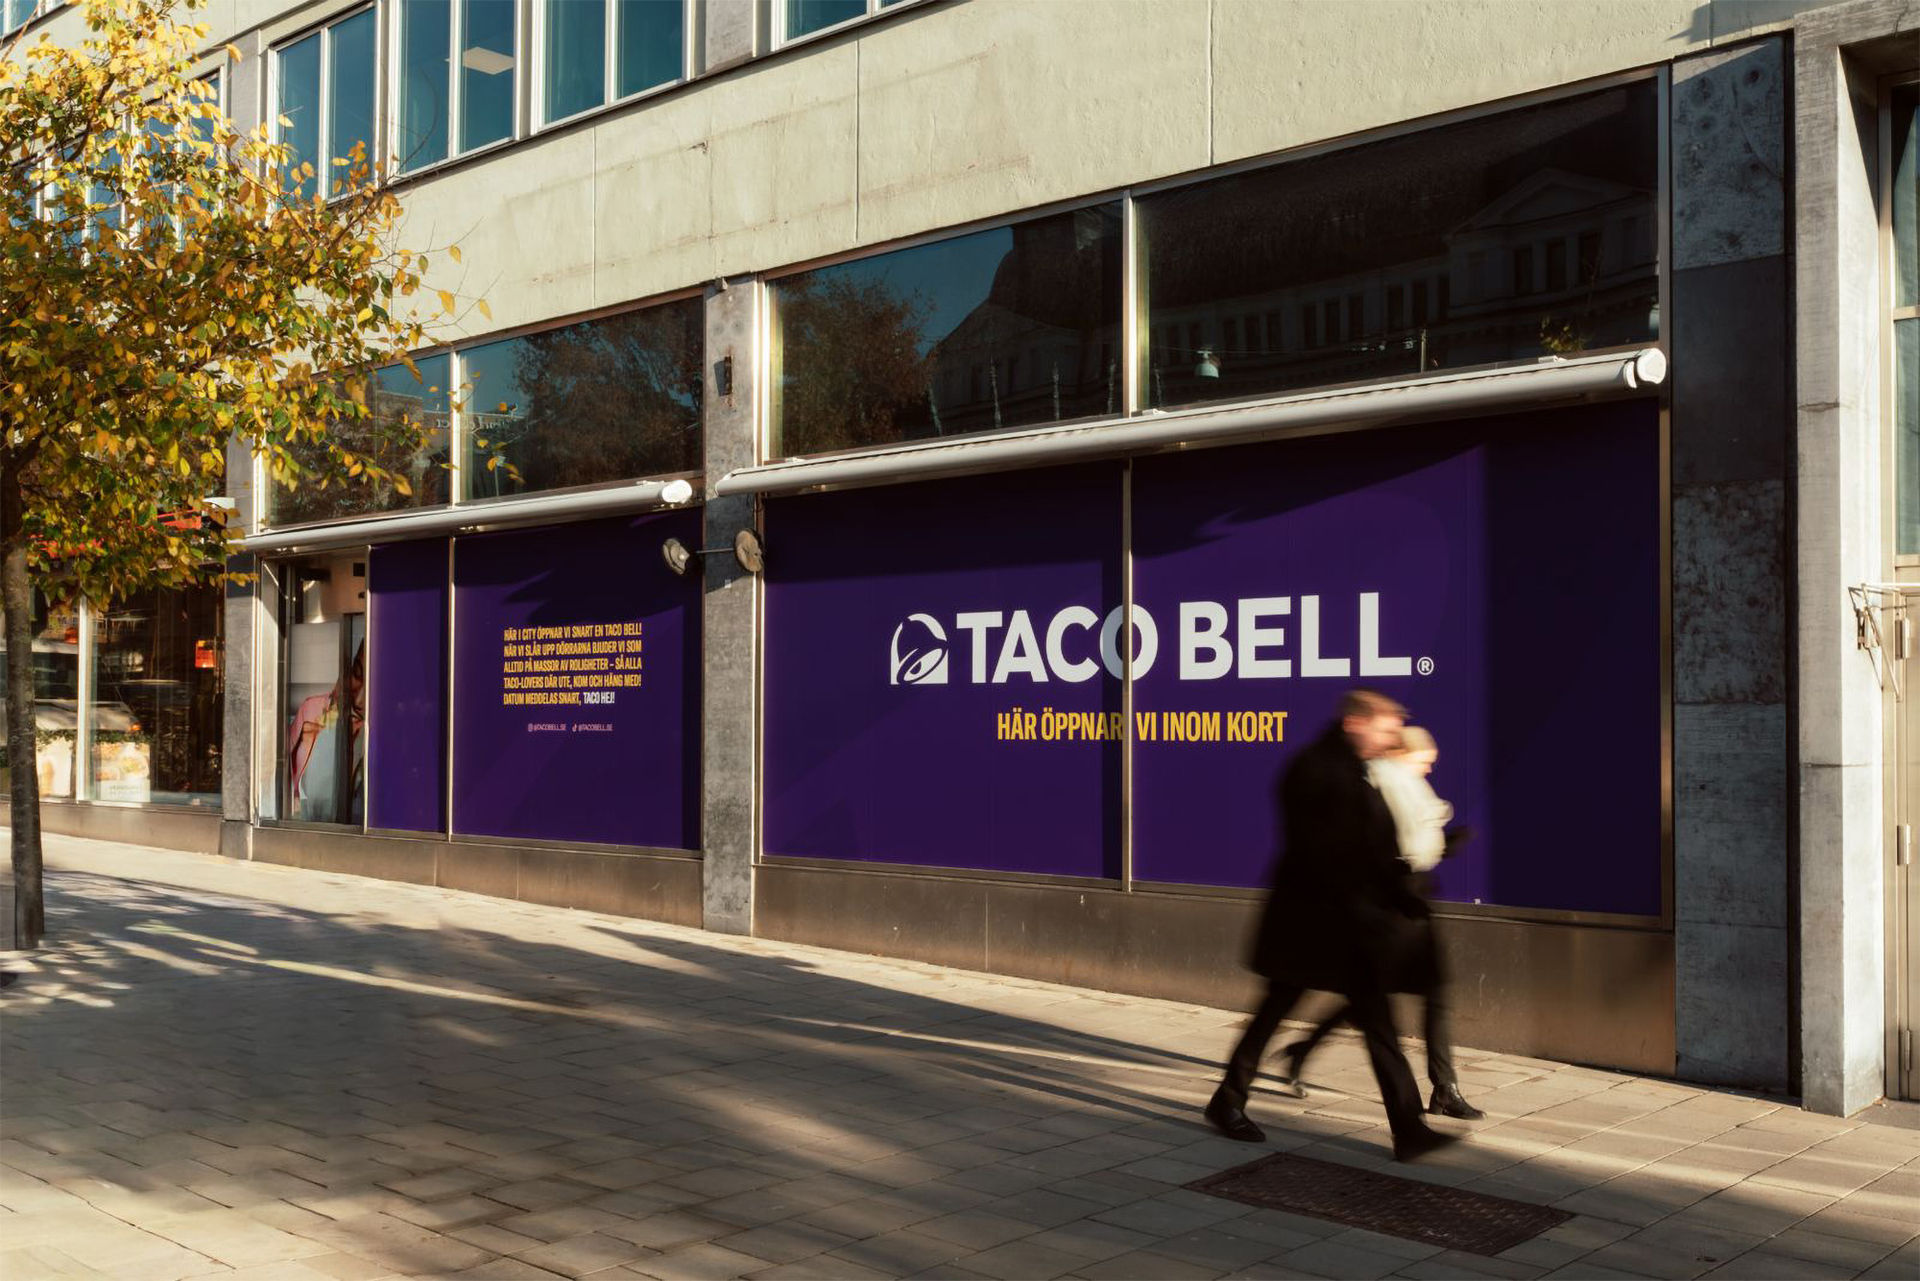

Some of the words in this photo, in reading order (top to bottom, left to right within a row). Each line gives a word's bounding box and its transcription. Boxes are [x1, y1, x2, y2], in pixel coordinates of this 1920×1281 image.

[522, 628, 536, 640] CITY
[537, 626, 563, 639] ÖPPNAR
[564, 626, 571, 638] VI
[572, 625, 594, 638] SNART
[595, 624, 603, 637] EN
[605, 624, 622, 636] TACO
[623, 622, 642, 635] BELL!
[518, 645, 524, 656] VI
[525, 641, 541, 656] SLÅR
[542, 643, 555, 656] UPP
[556, 641, 591, 655] DÖRRARNA
[592, 641, 617, 653] BJUDER
[618, 640, 625, 653] VI
[626, 640, 642, 653] SOM
[956, 604, 1159, 684] TACO
[504, 661, 524, 673] ALLTID
[525, 657, 533, 672] PÅ
[534, 660, 559, 672] MASSOR
[560, 659, 568, 671] AV
[569, 658, 608, 671] ROLIGHETER
[615, 654, 624, 670] SÅ
[625, 657, 642, 670] ALLA
[504, 676, 543, 688] TACO-LOVERS
[544, 674, 558, 688] DÄR
[558, 676, 572, 689] UTE,
[573, 675, 588, 688] KOM
[589, 675, 603, 687] OCH
[604, 672, 623, 687] HÄNG
[624, 674, 642, 686] MED!
[504, 692, 524, 705] DATUM
[525, 692, 558, 704] MEDDELAS
[559, 692, 581, 706] SNART,
[583, 692, 600, 704] TACO
[601, 691, 615, 704] HEJ!
[997, 707, 1037, 741] HÄR
[1041, 707, 1124, 742] ÖPPNAR
[1136, 712, 1159, 742] VI
[1162, 711, 1222, 743] INOM
[1226, 710, 1287, 743] KORT
